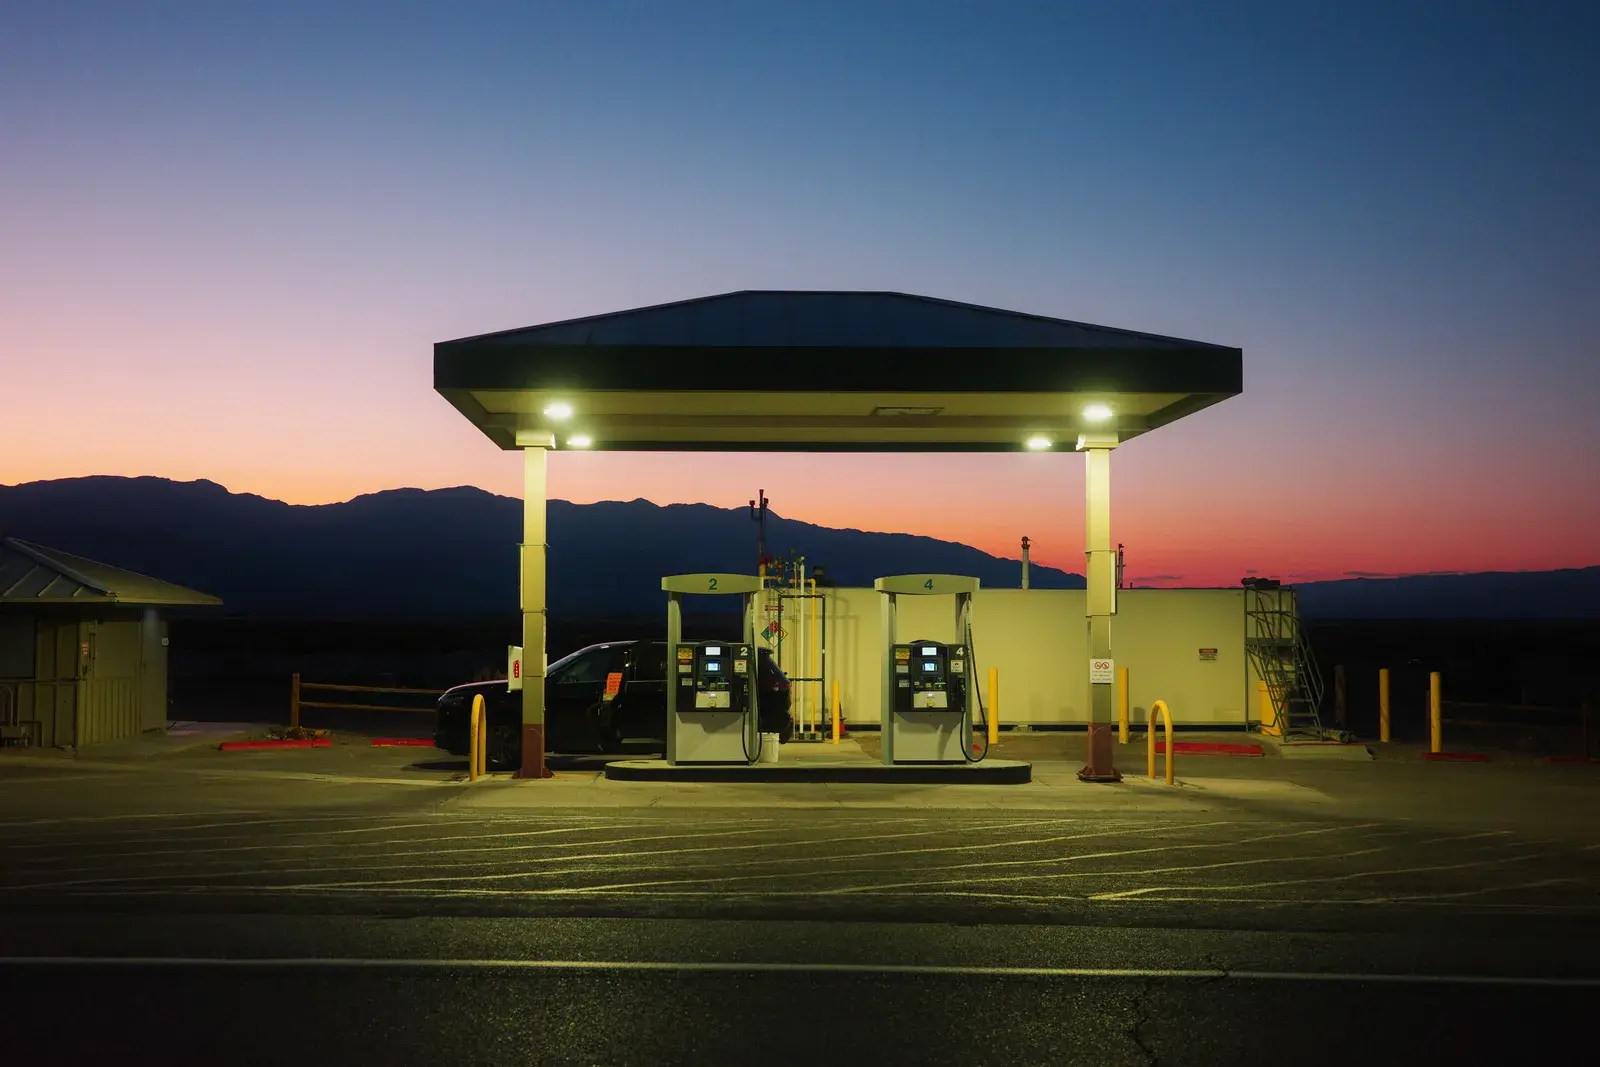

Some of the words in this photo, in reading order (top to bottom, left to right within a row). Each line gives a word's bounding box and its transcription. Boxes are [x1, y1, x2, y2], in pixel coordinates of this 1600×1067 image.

[708, 578, 718, 590] 2
[924, 578, 934, 590] 4
[740, 646, 748, 656] 2
[956, 646, 964, 656] 4
